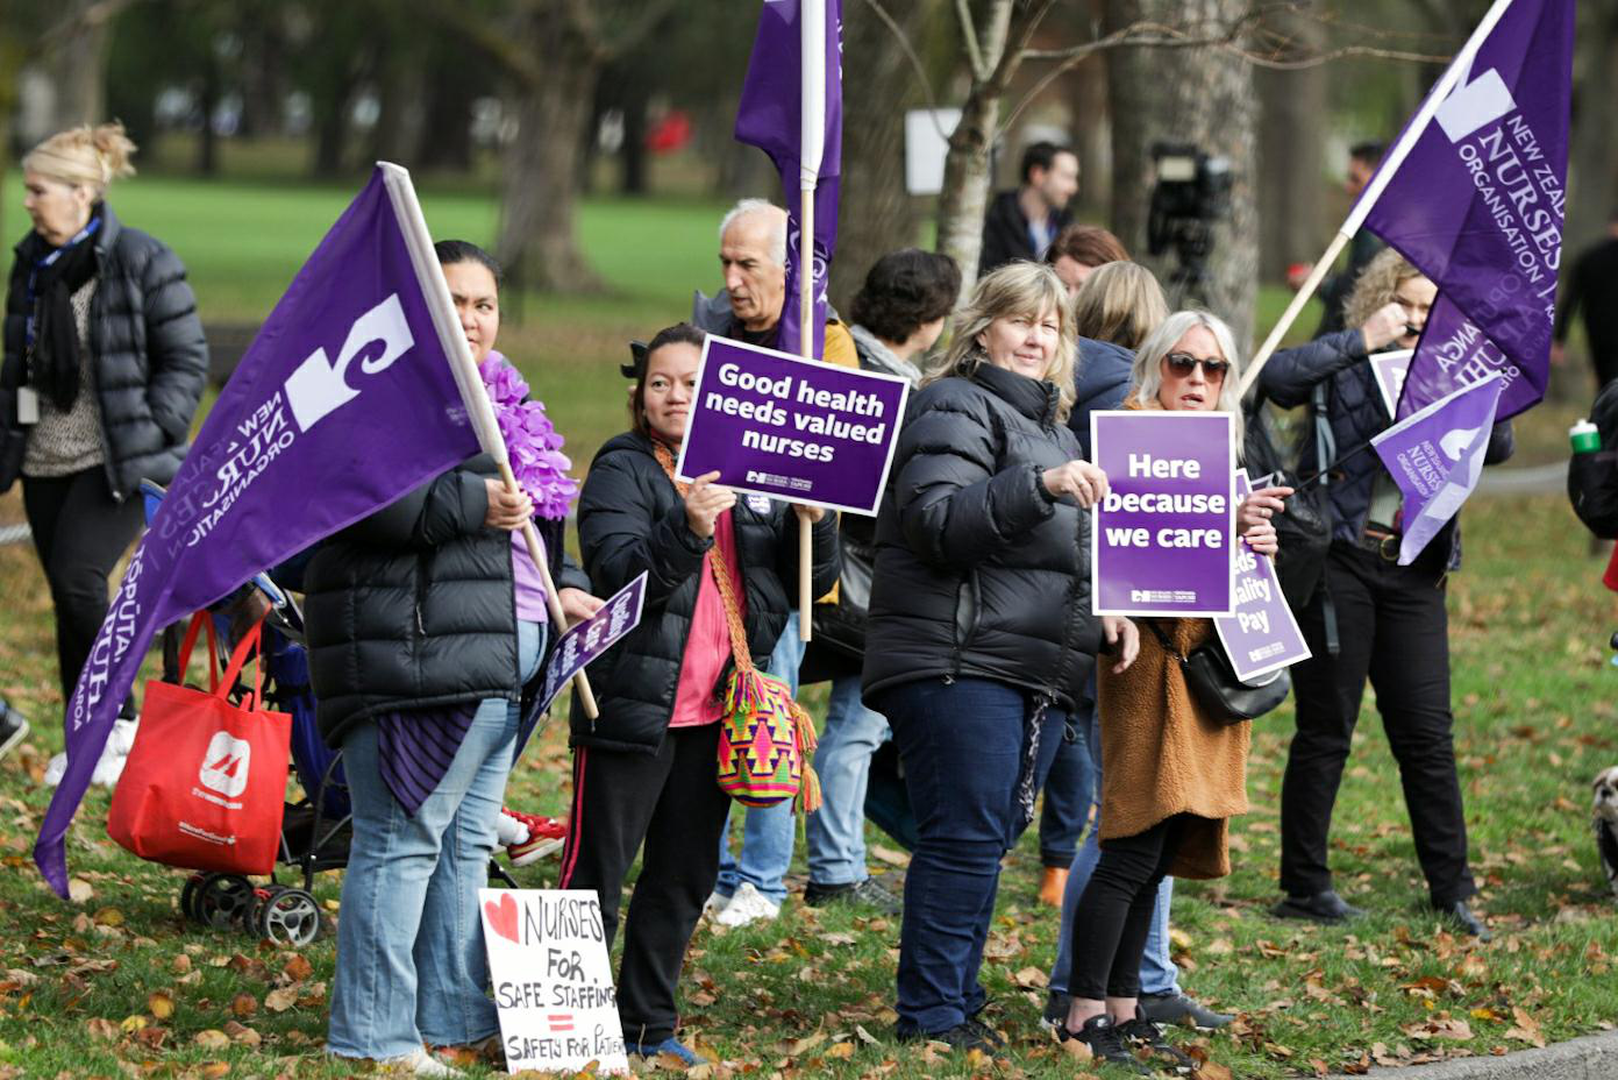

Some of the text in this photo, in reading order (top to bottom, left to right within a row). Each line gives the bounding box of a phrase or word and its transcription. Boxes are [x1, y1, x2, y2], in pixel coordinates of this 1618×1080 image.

[1507, 114, 1566, 220] NEW ZEAL
[1459, 144, 1545, 283] ORGANISATION
[1477, 126, 1562, 270] NURSES
[718, 362, 885, 417] Good health
[705, 391, 886, 445] needs valued
[741, 430, 835, 463] nurses
[1128, 453, 1201, 479] Here
[1406, 445, 1442, 491] NURSES
[1103, 487, 1225, 514] because
[1105, 528, 1149, 547] we
[1157, 528, 1223, 548] care
[1235, 548, 1258, 575] eds
[1235, 577, 1272, 606] ality
[1237, 609, 1270, 634] Pay
[525, 895, 604, 946] NURSES
[498, 981, 545, 1009] SAFE
[567, 1037, 590, 1057] FOR
